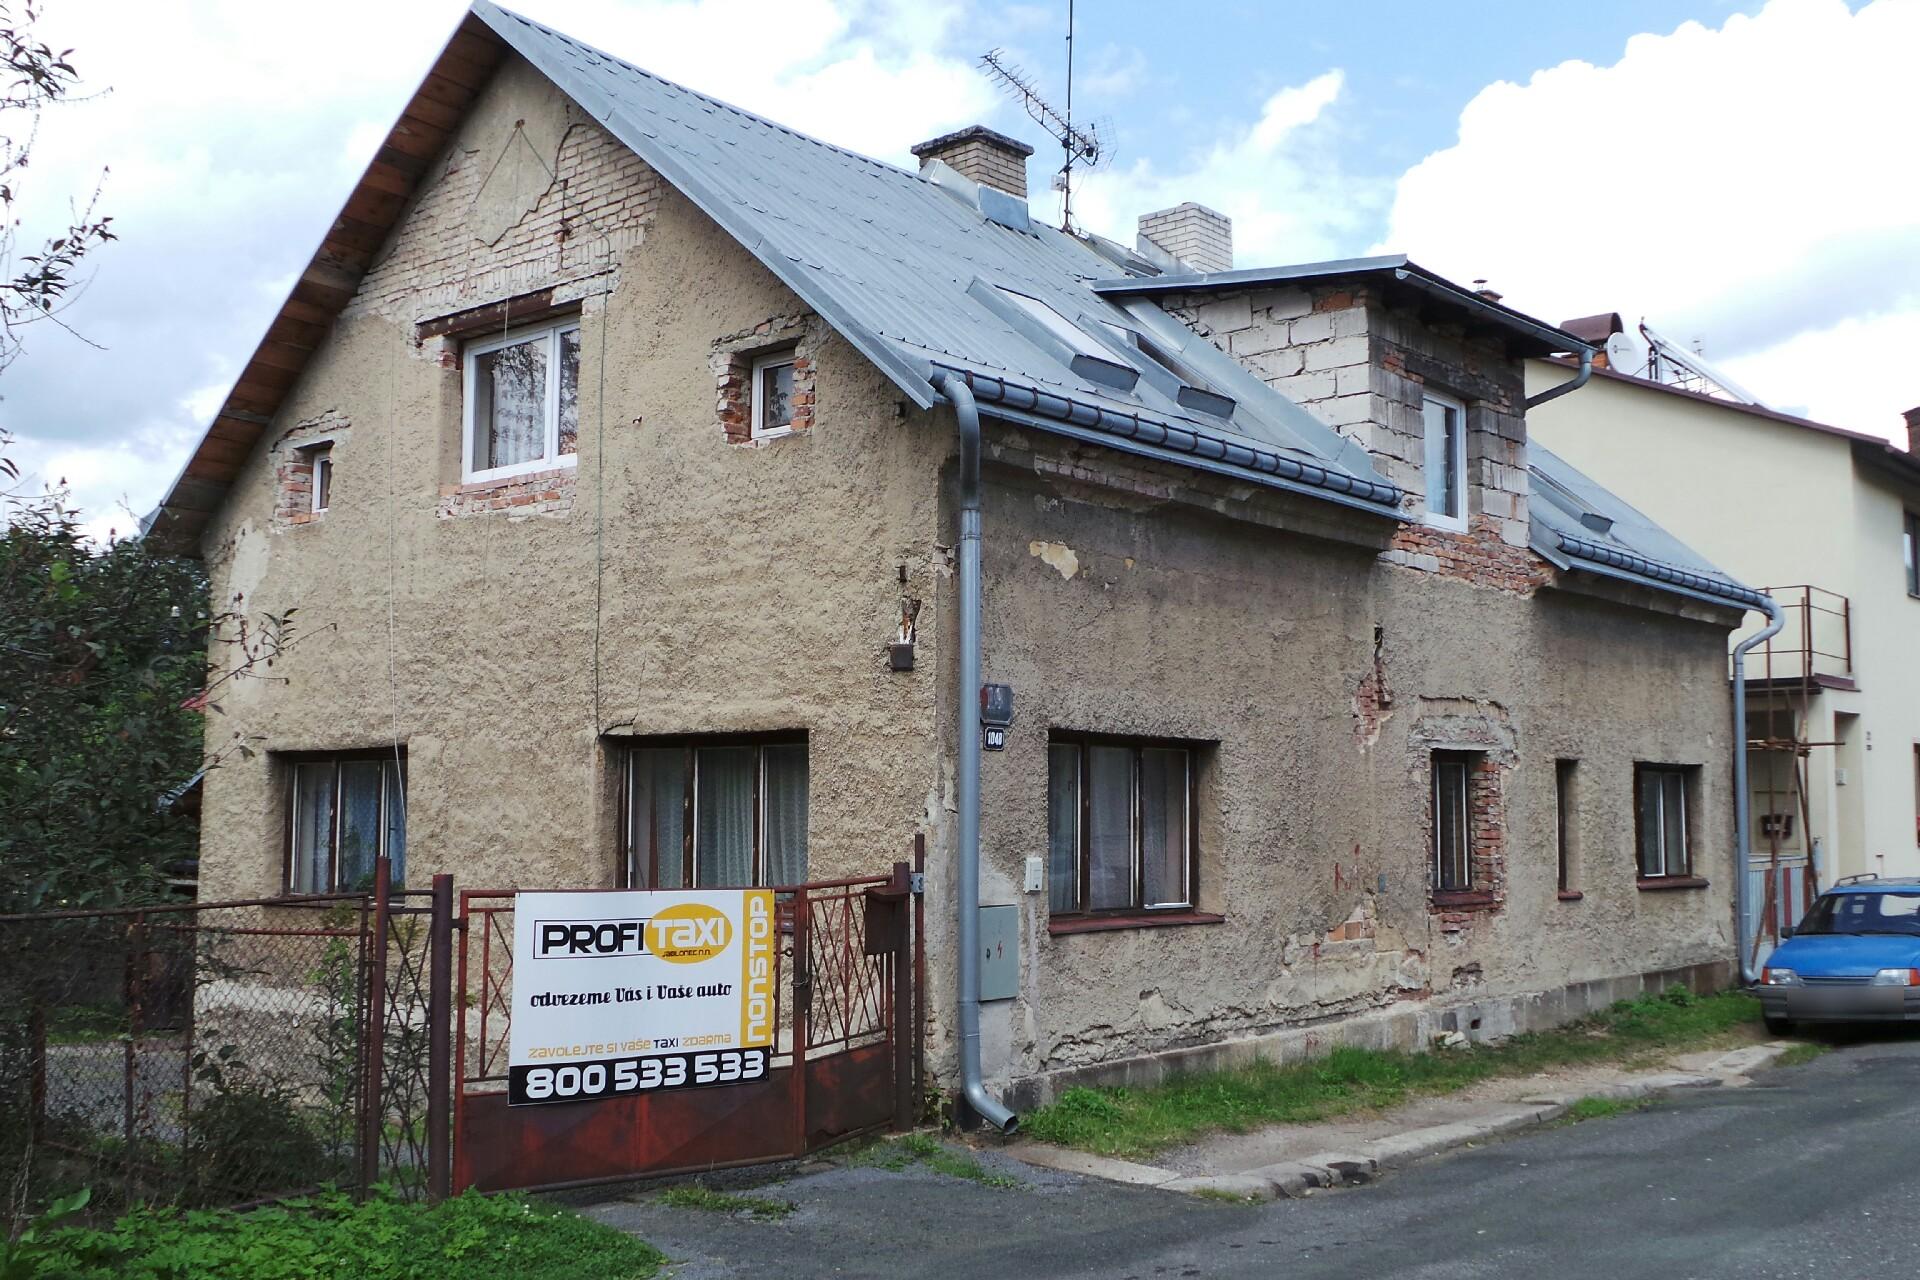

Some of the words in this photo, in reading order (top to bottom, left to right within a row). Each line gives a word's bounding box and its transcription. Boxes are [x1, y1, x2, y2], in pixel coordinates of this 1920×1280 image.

[541, 922, 645, 955] PROFI
[530, 991, 612, 1008] odvezeme
[615, 986, 643, 1003] Vás
[646, 985, 653, 1001] i
[656, 984, 694, 1000] Vaše
[696, 982, 732, 998] auto
[525, 1064, 607, 1099] 800
[614, 1056, 687, 1091] 533
[694, 1050, 764, 1084] 533
